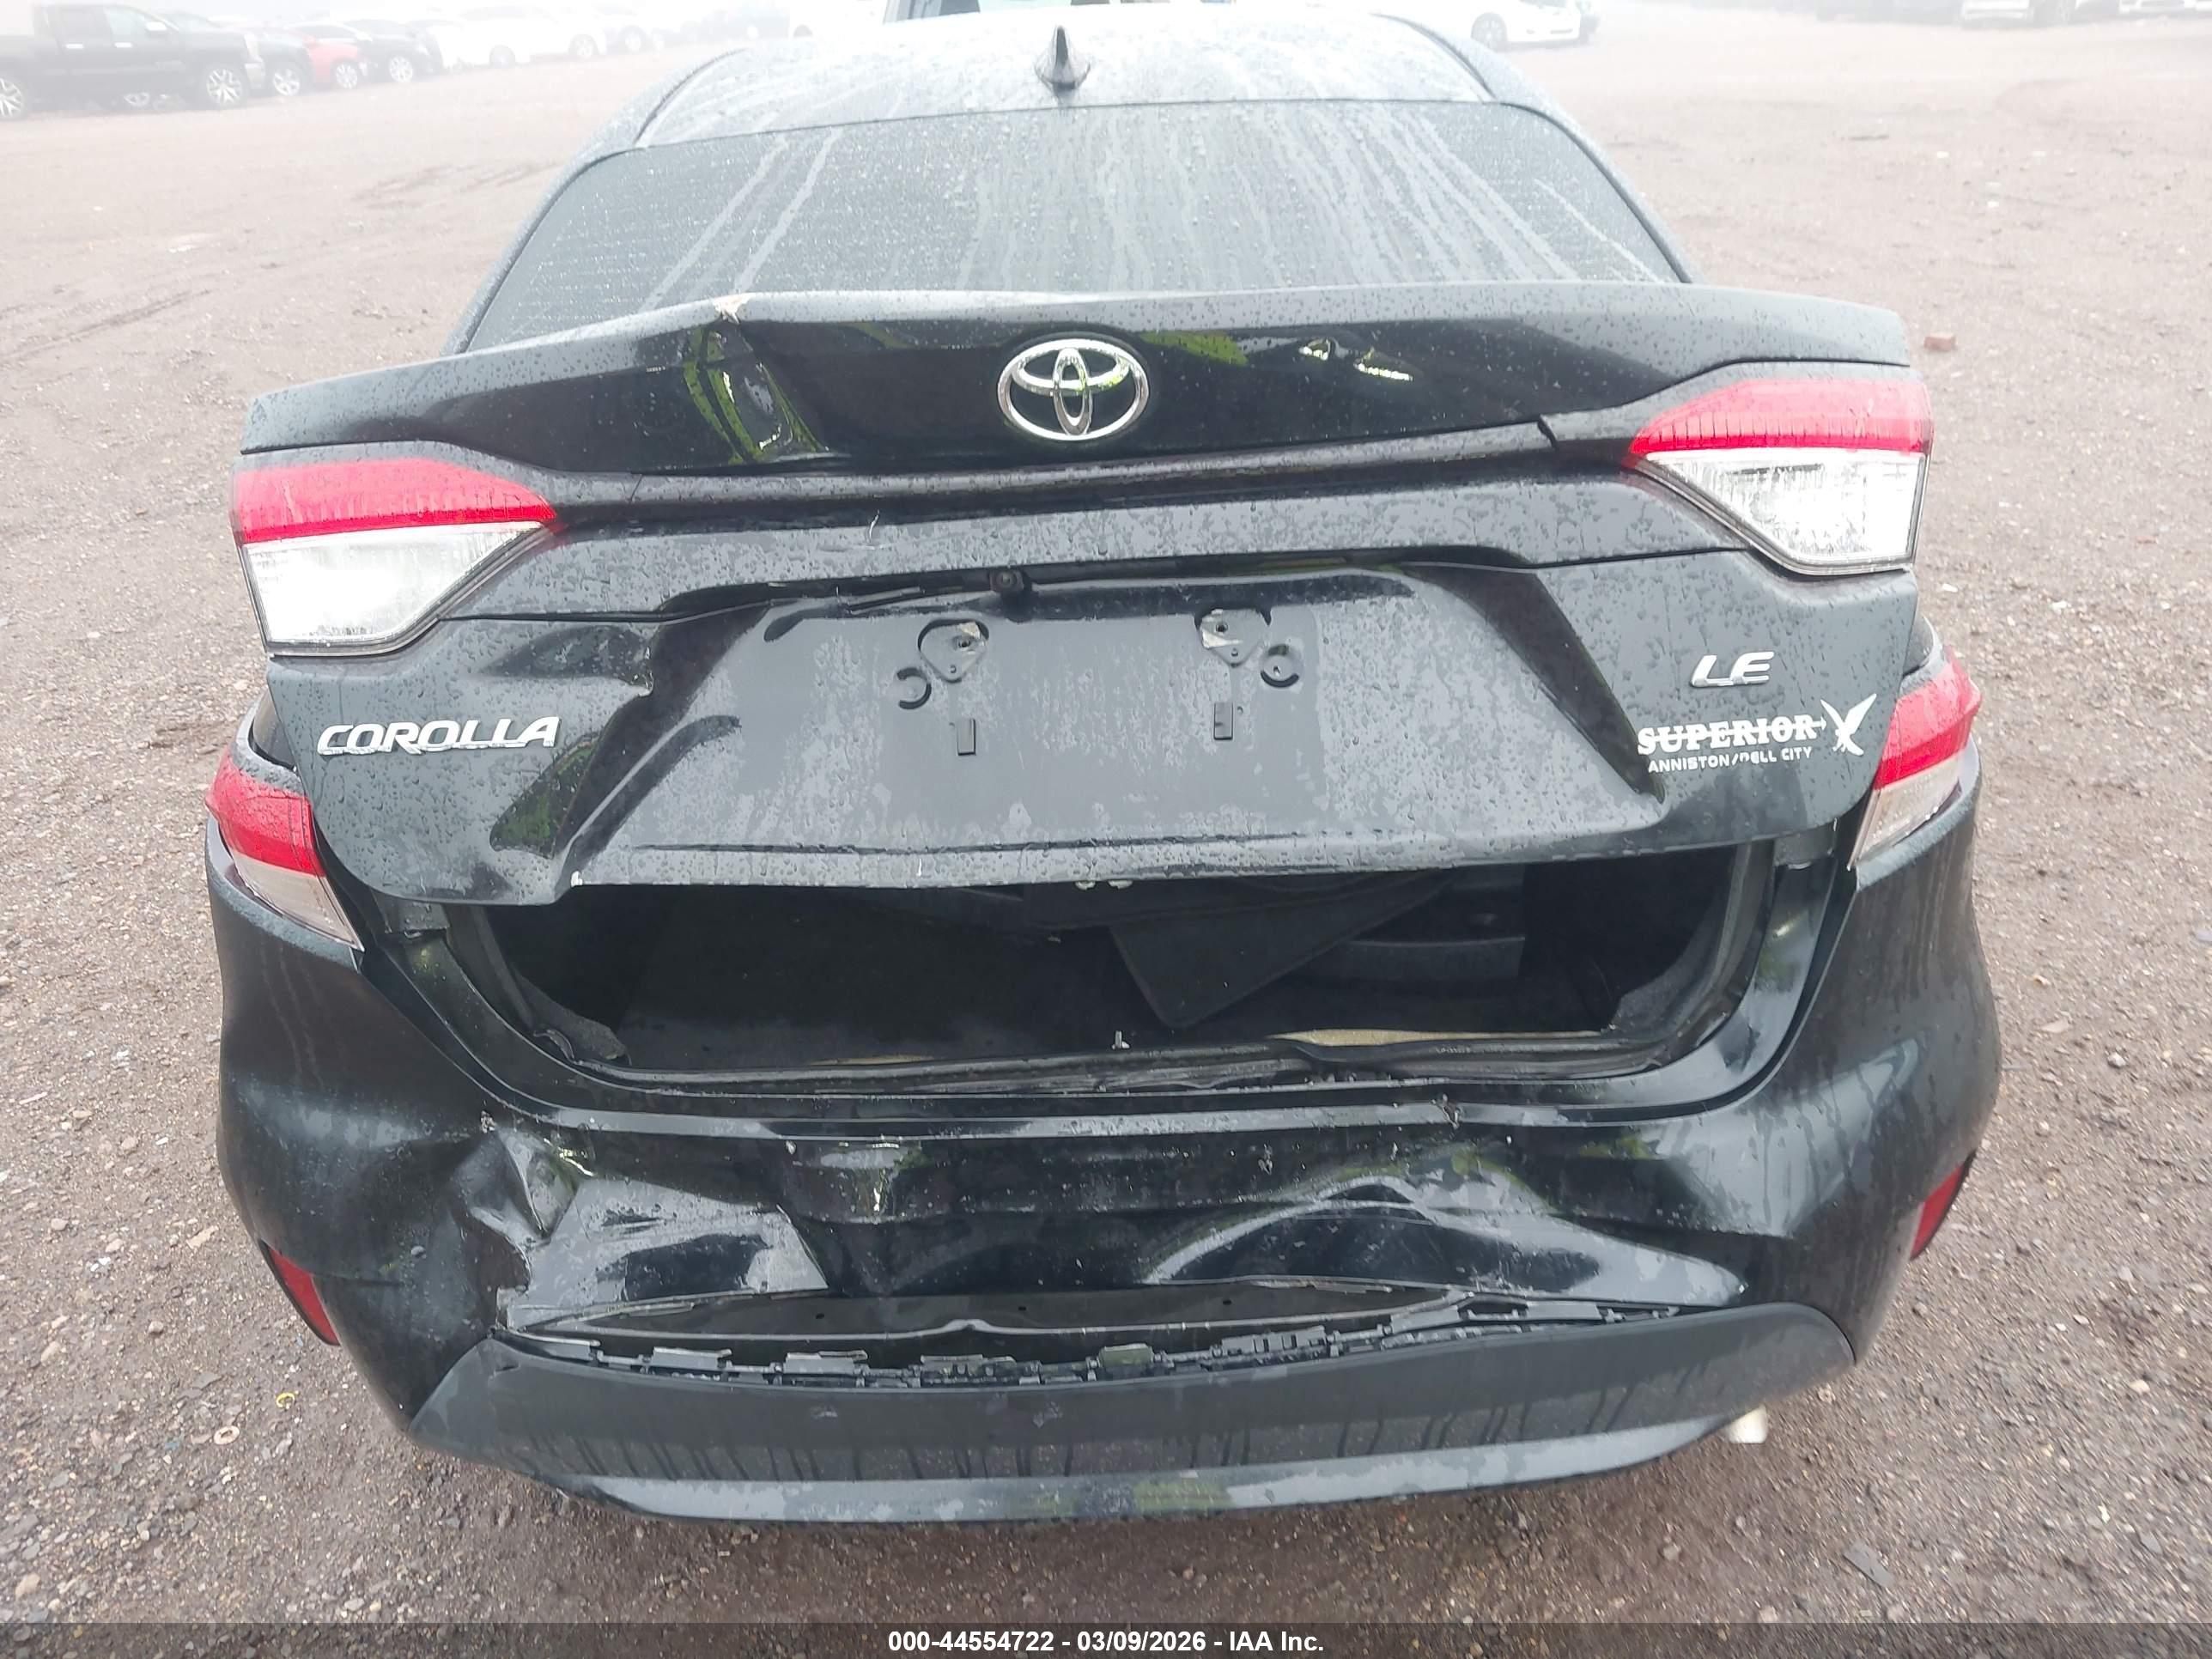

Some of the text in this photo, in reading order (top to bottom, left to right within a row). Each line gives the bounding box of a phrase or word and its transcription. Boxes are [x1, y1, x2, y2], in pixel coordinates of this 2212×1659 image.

[1690, 651, 1775, 688] LE
[317, 716, 560, 756] COROLLA
[1637, 714, 1818, 756] SUPERIOR
[1782, 746, 1813, 762] CITY
